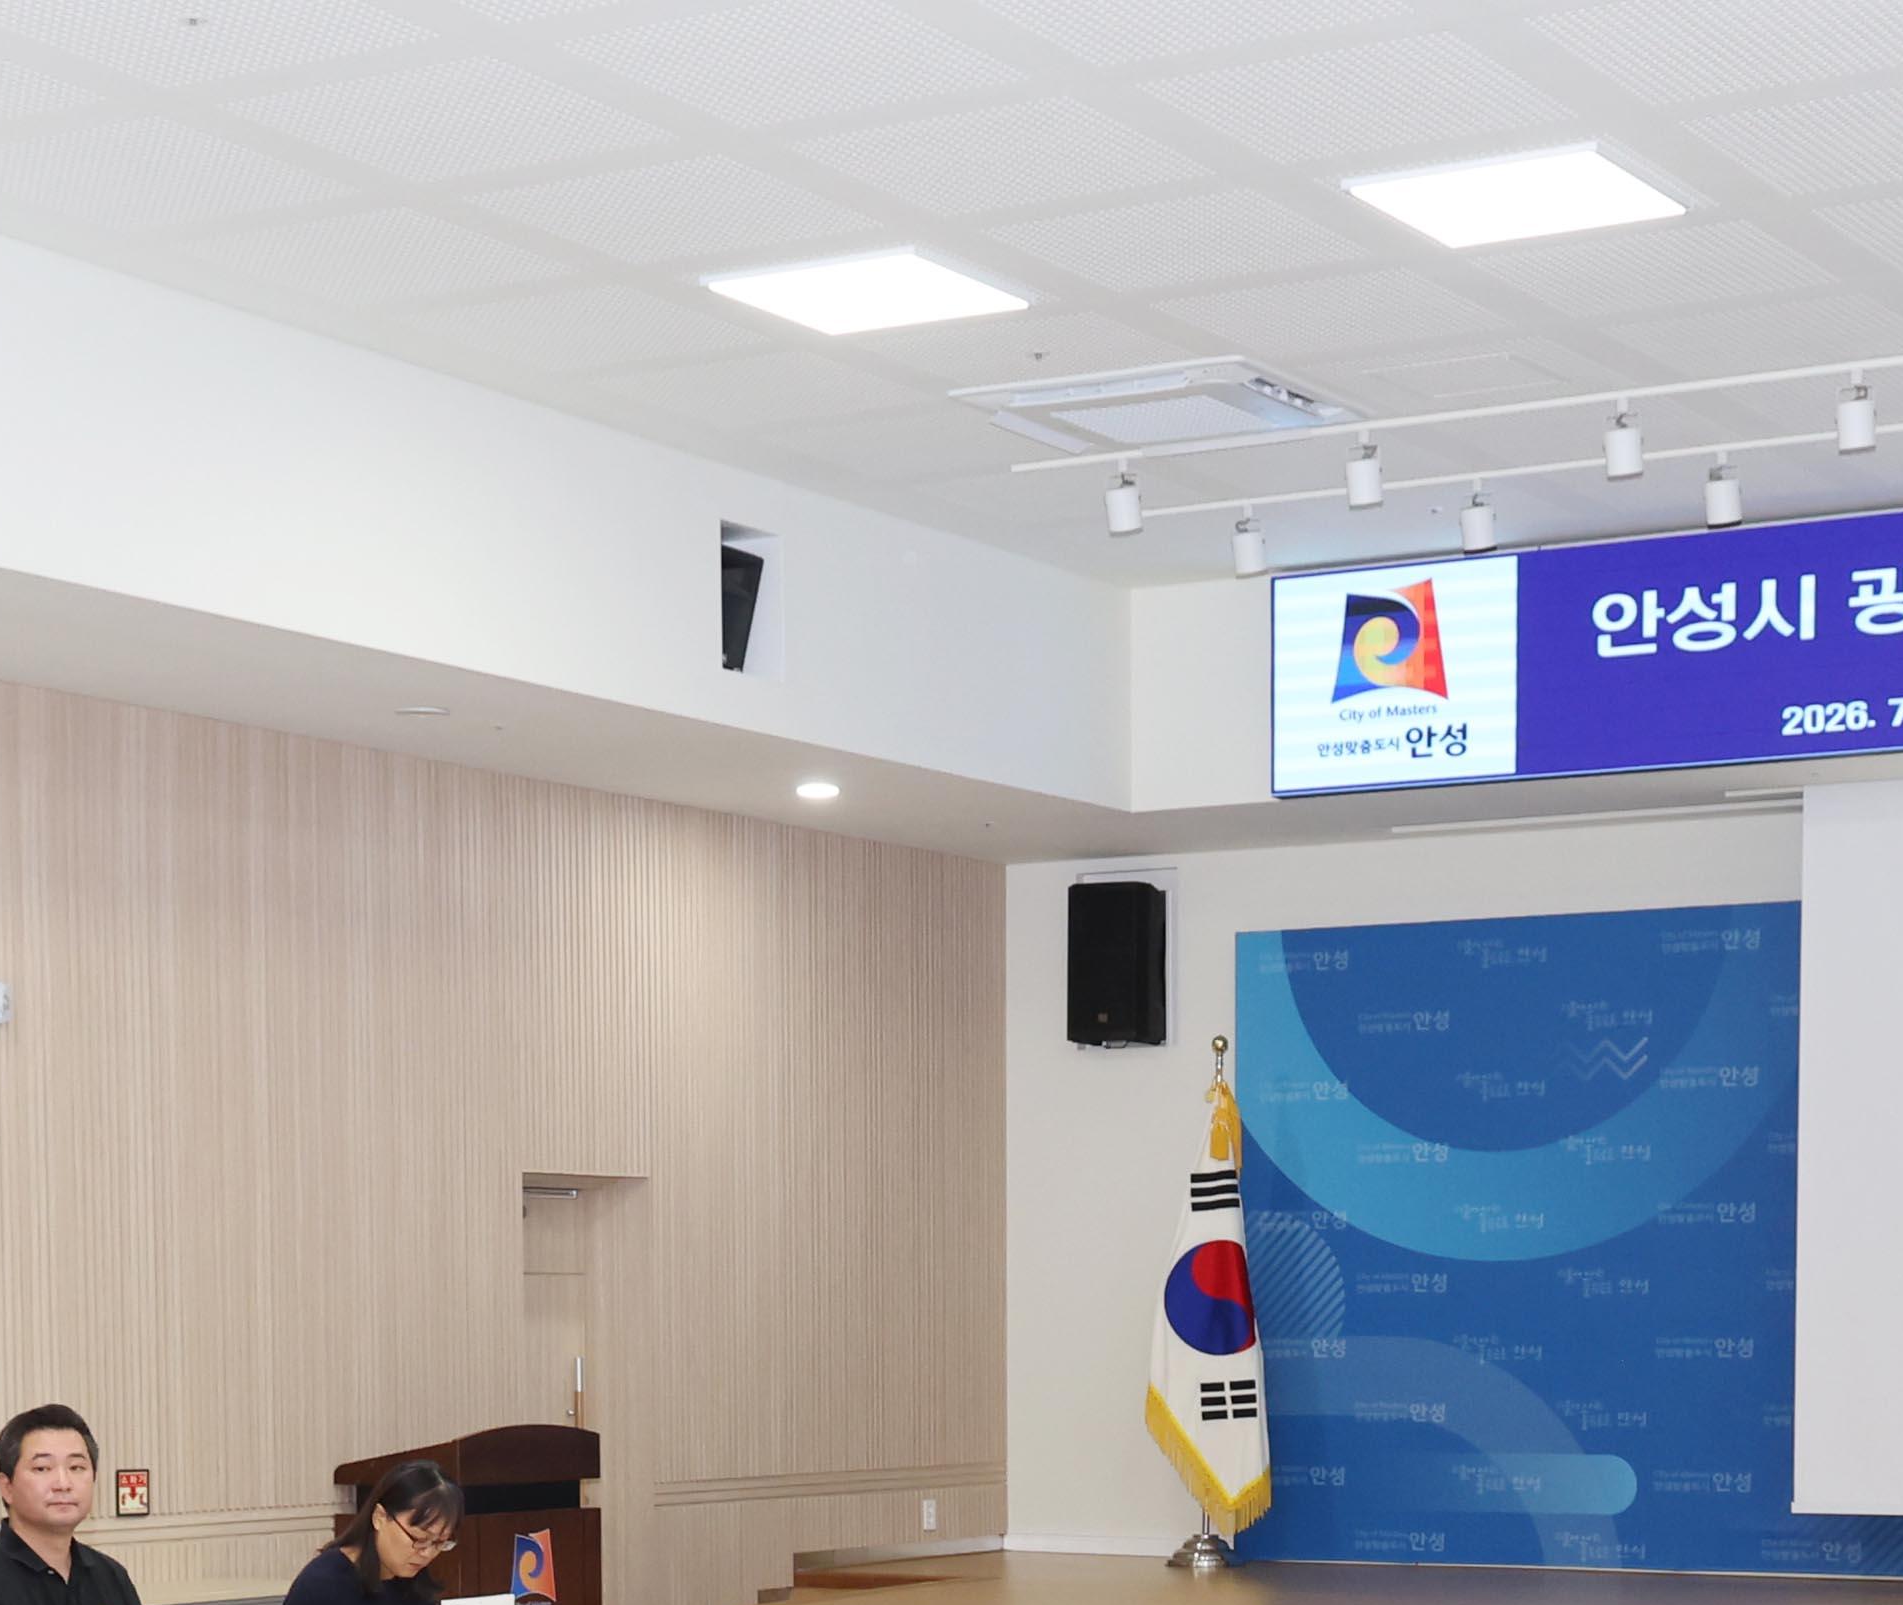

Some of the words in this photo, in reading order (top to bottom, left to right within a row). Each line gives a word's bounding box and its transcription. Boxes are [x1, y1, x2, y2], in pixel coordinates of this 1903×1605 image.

[1592, 575, 1815, 658] 안성시
[1339, 708, 1364, 723] City
[1369, 705, 1384, 719] of
[1386, 703, 1438, 718] Masters
[1781, 700, 1875, 737] 2026.
[1404, 721, 1469, 759] 안성
